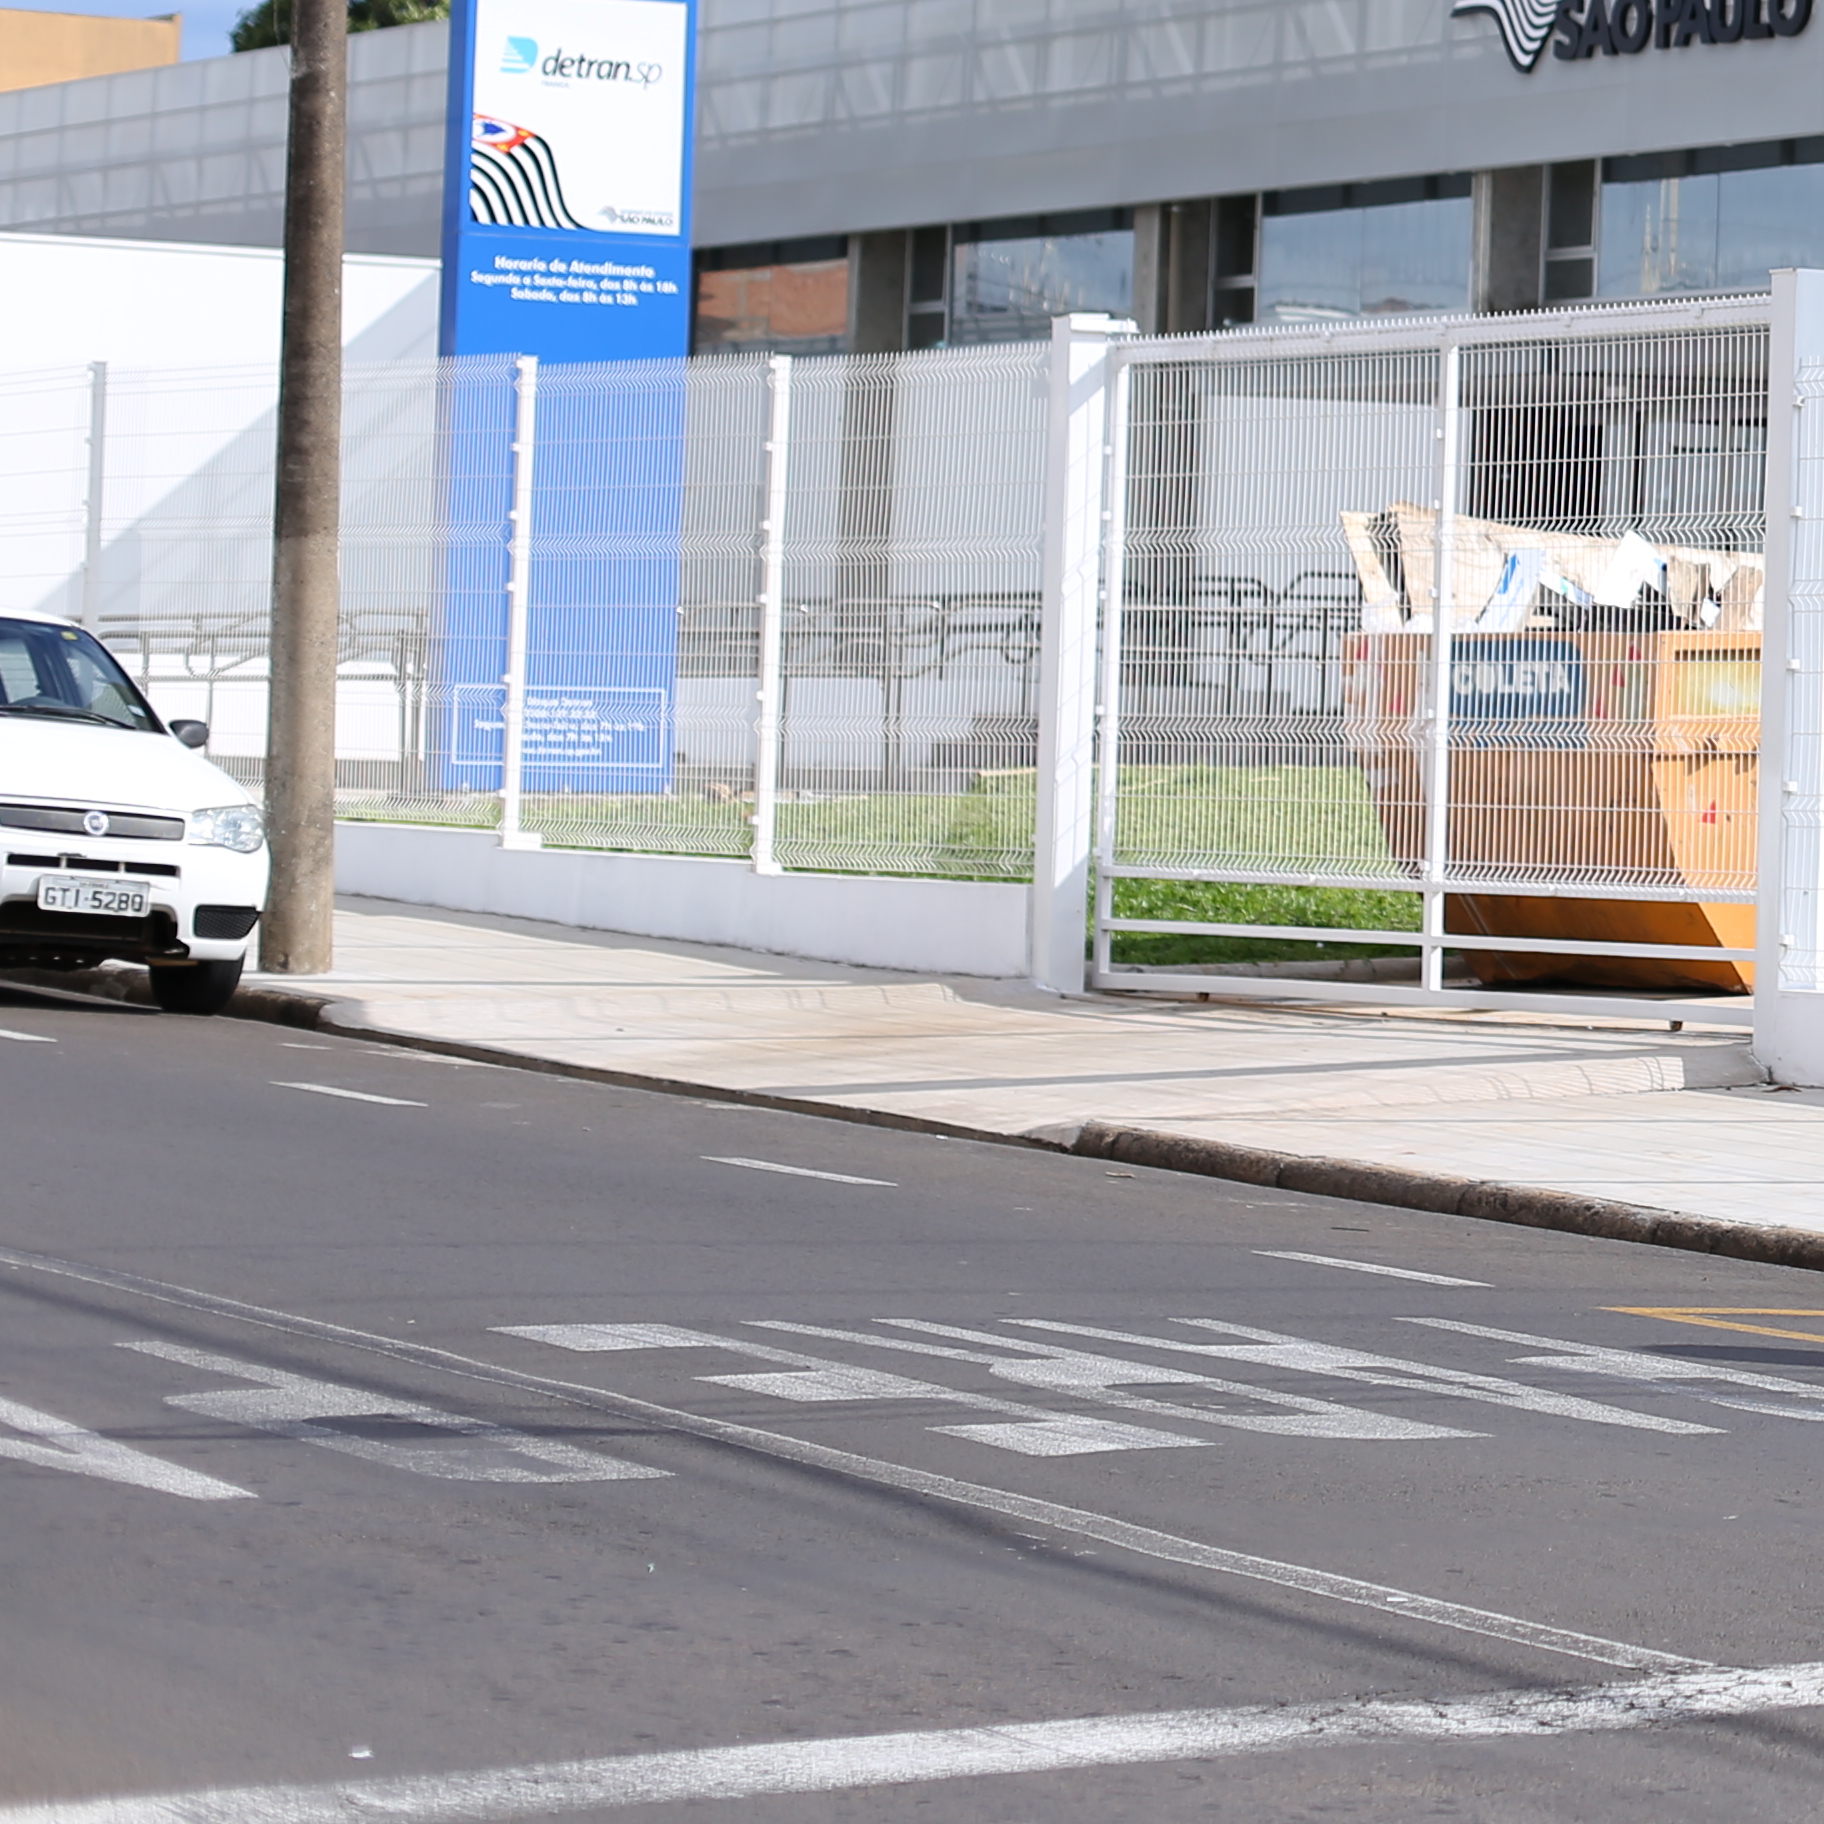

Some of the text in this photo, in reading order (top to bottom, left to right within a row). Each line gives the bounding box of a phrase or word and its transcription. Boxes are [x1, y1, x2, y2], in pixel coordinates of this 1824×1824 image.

[541, 48, 662, 89] detran.sp
[470, 269, 520, 287] Segunda
[569, 259, 656, 279] Atendimento
[1453, 661, 1571, 695] COLETA
